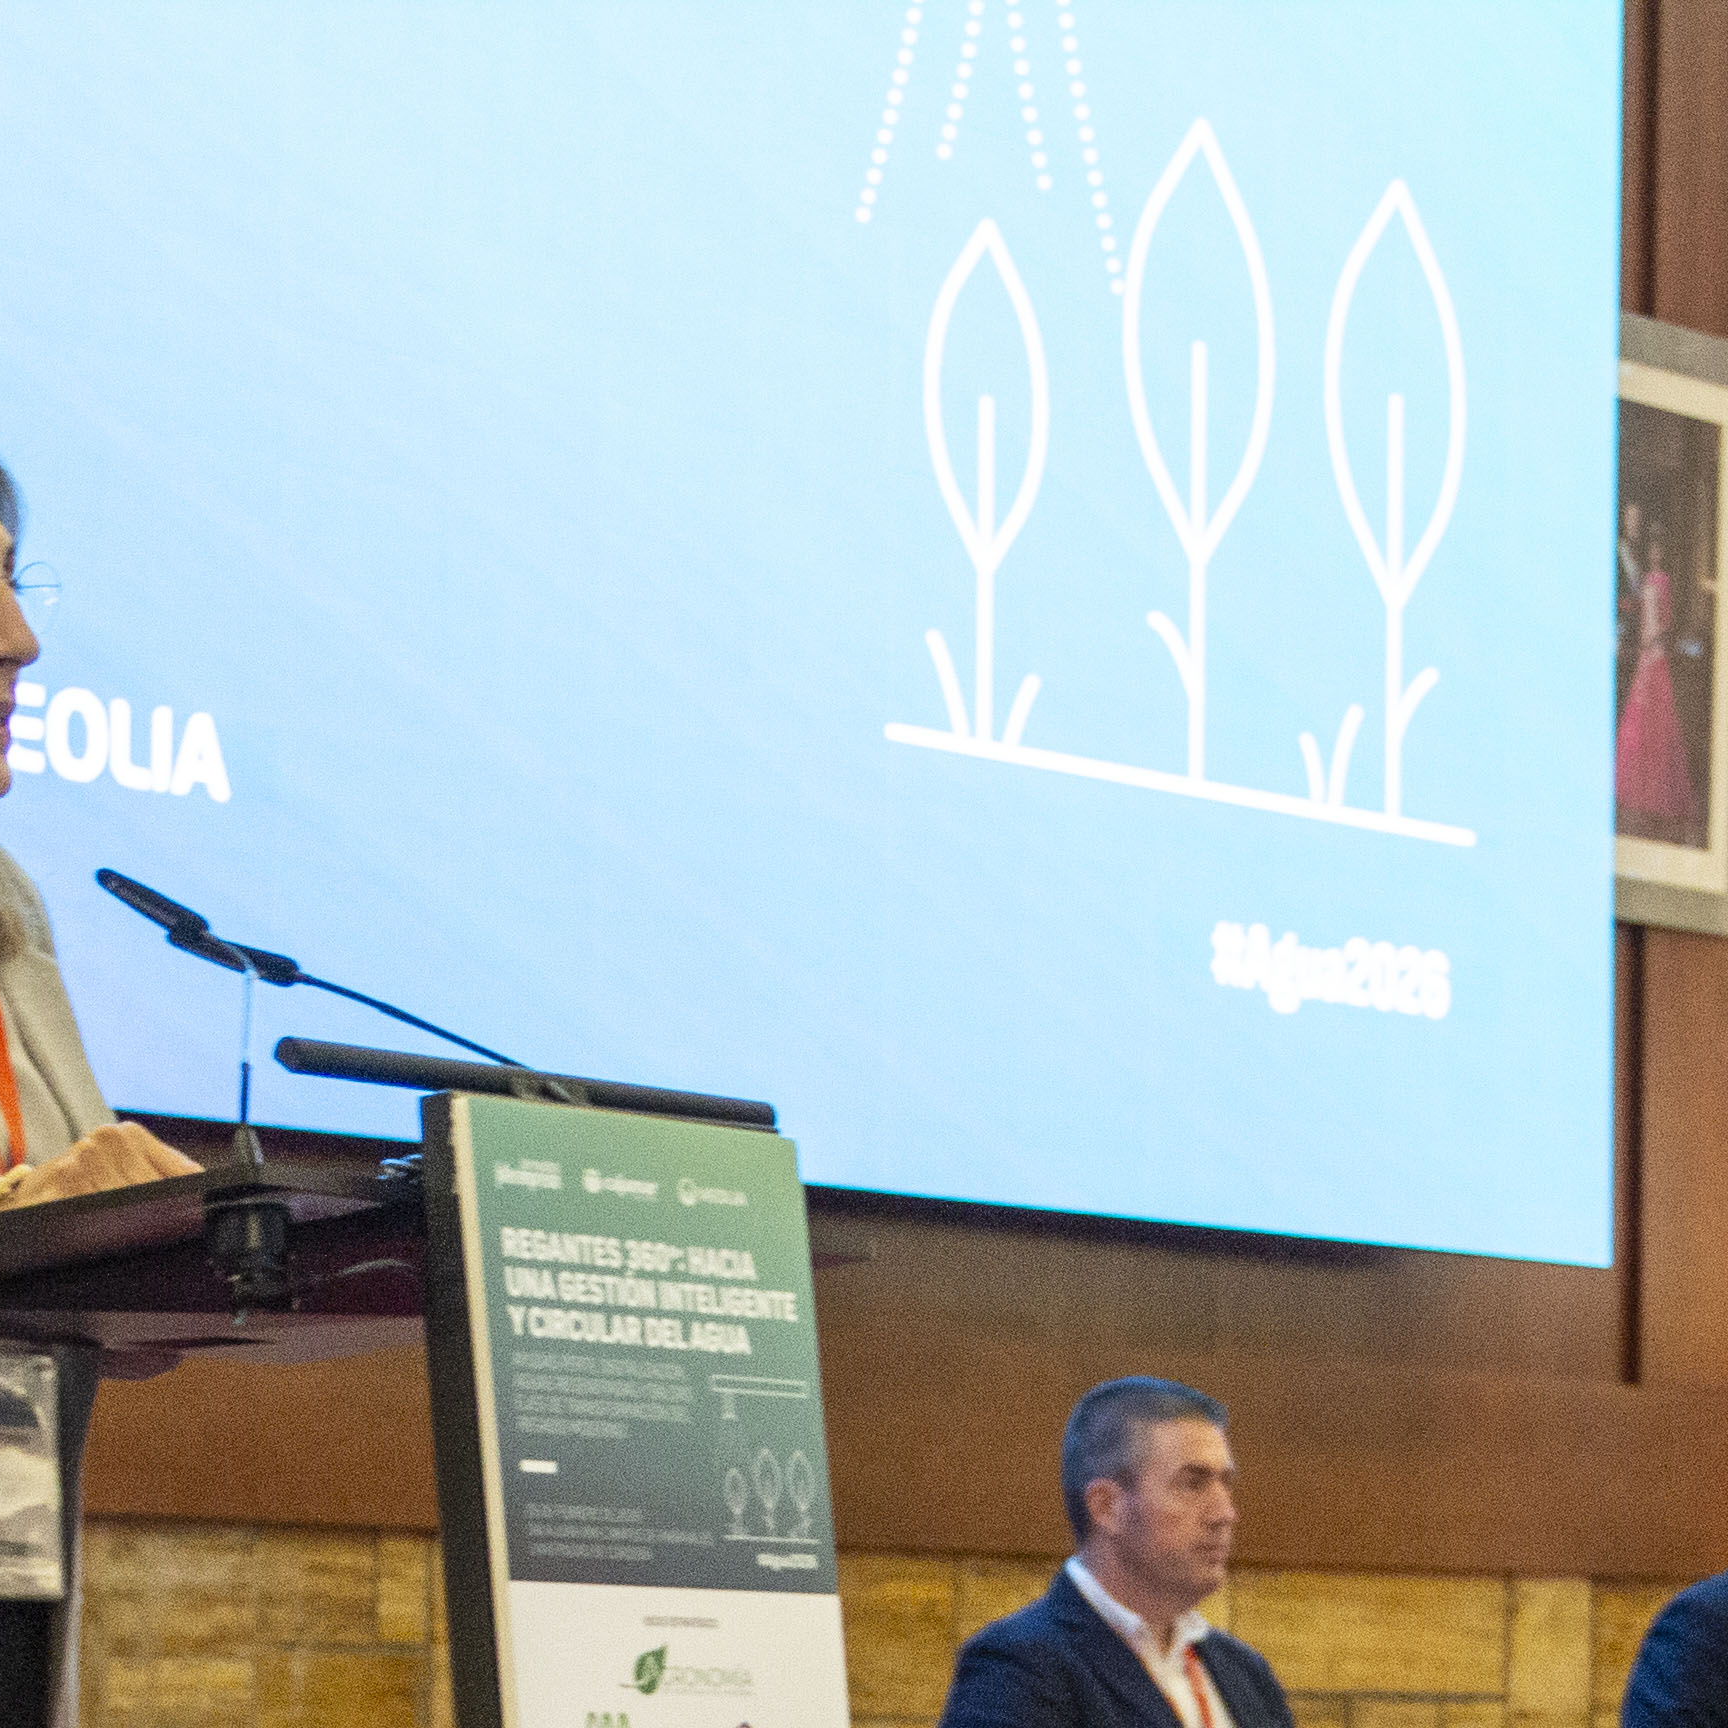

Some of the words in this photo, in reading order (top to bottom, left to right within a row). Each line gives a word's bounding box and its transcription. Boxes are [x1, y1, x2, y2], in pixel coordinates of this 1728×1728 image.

[6, 680, 233, 804] EOLIA
[1210, 920, 1451, 1020] #Agua2026
[500, 1226, 623, 1269] REGANTES
[687, 1245, 757, 1280] HACIA
[503, 1266, 556, 1299] UNA
[557, 1267, 656, 1309] GESTIÓN
[658, 1280, 799, 1323] INTELIGENTE
[506, 1305, 525, 1336] Y
[528, 1305, 643, 1346] CIRCULAR
[644, 1315, 687, 1349] DEL
[688, 1320, 752, 1356] AGUA
